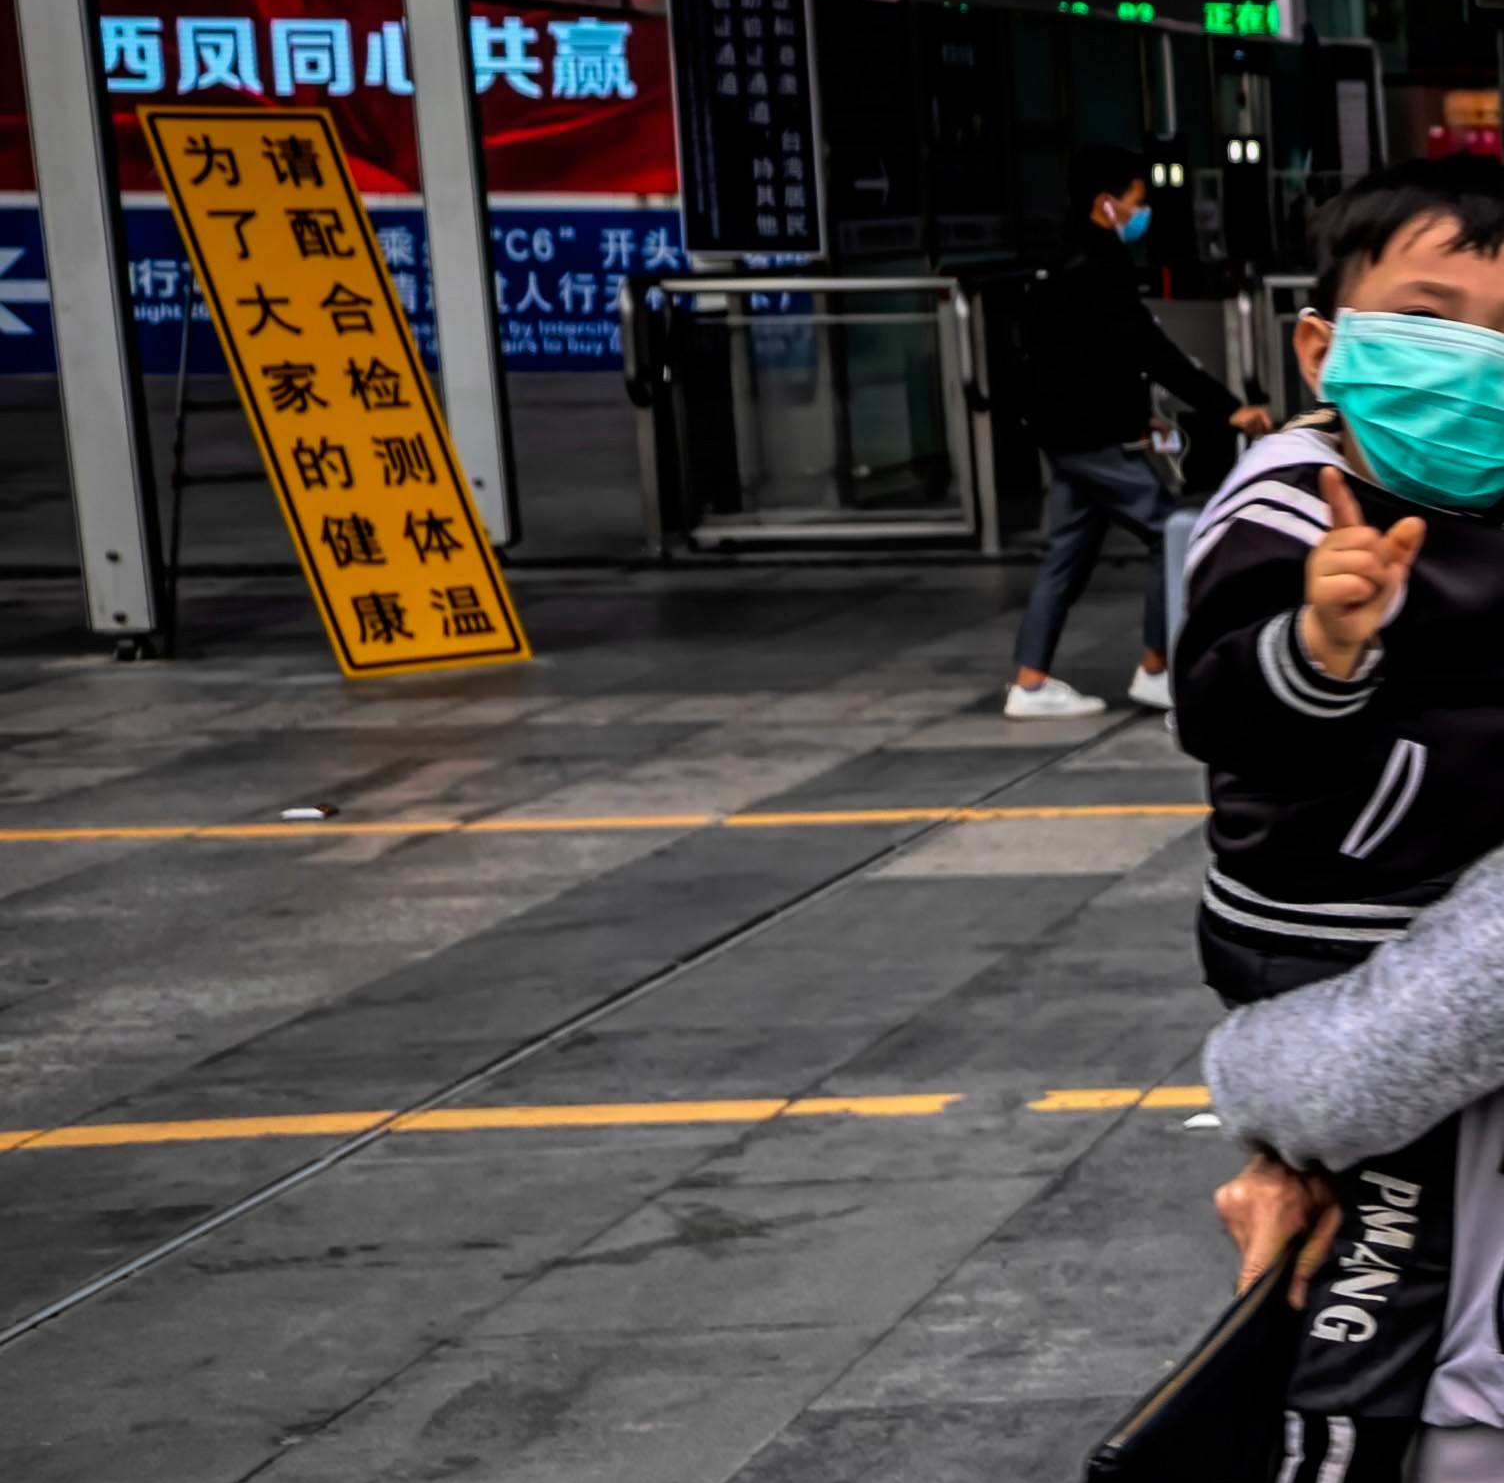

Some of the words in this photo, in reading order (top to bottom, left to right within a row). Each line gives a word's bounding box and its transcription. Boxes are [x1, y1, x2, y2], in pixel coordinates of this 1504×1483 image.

[182, 134, 417, 647] 为了大家的健康
[261, 133, 498, 640] 请配合检测体温
